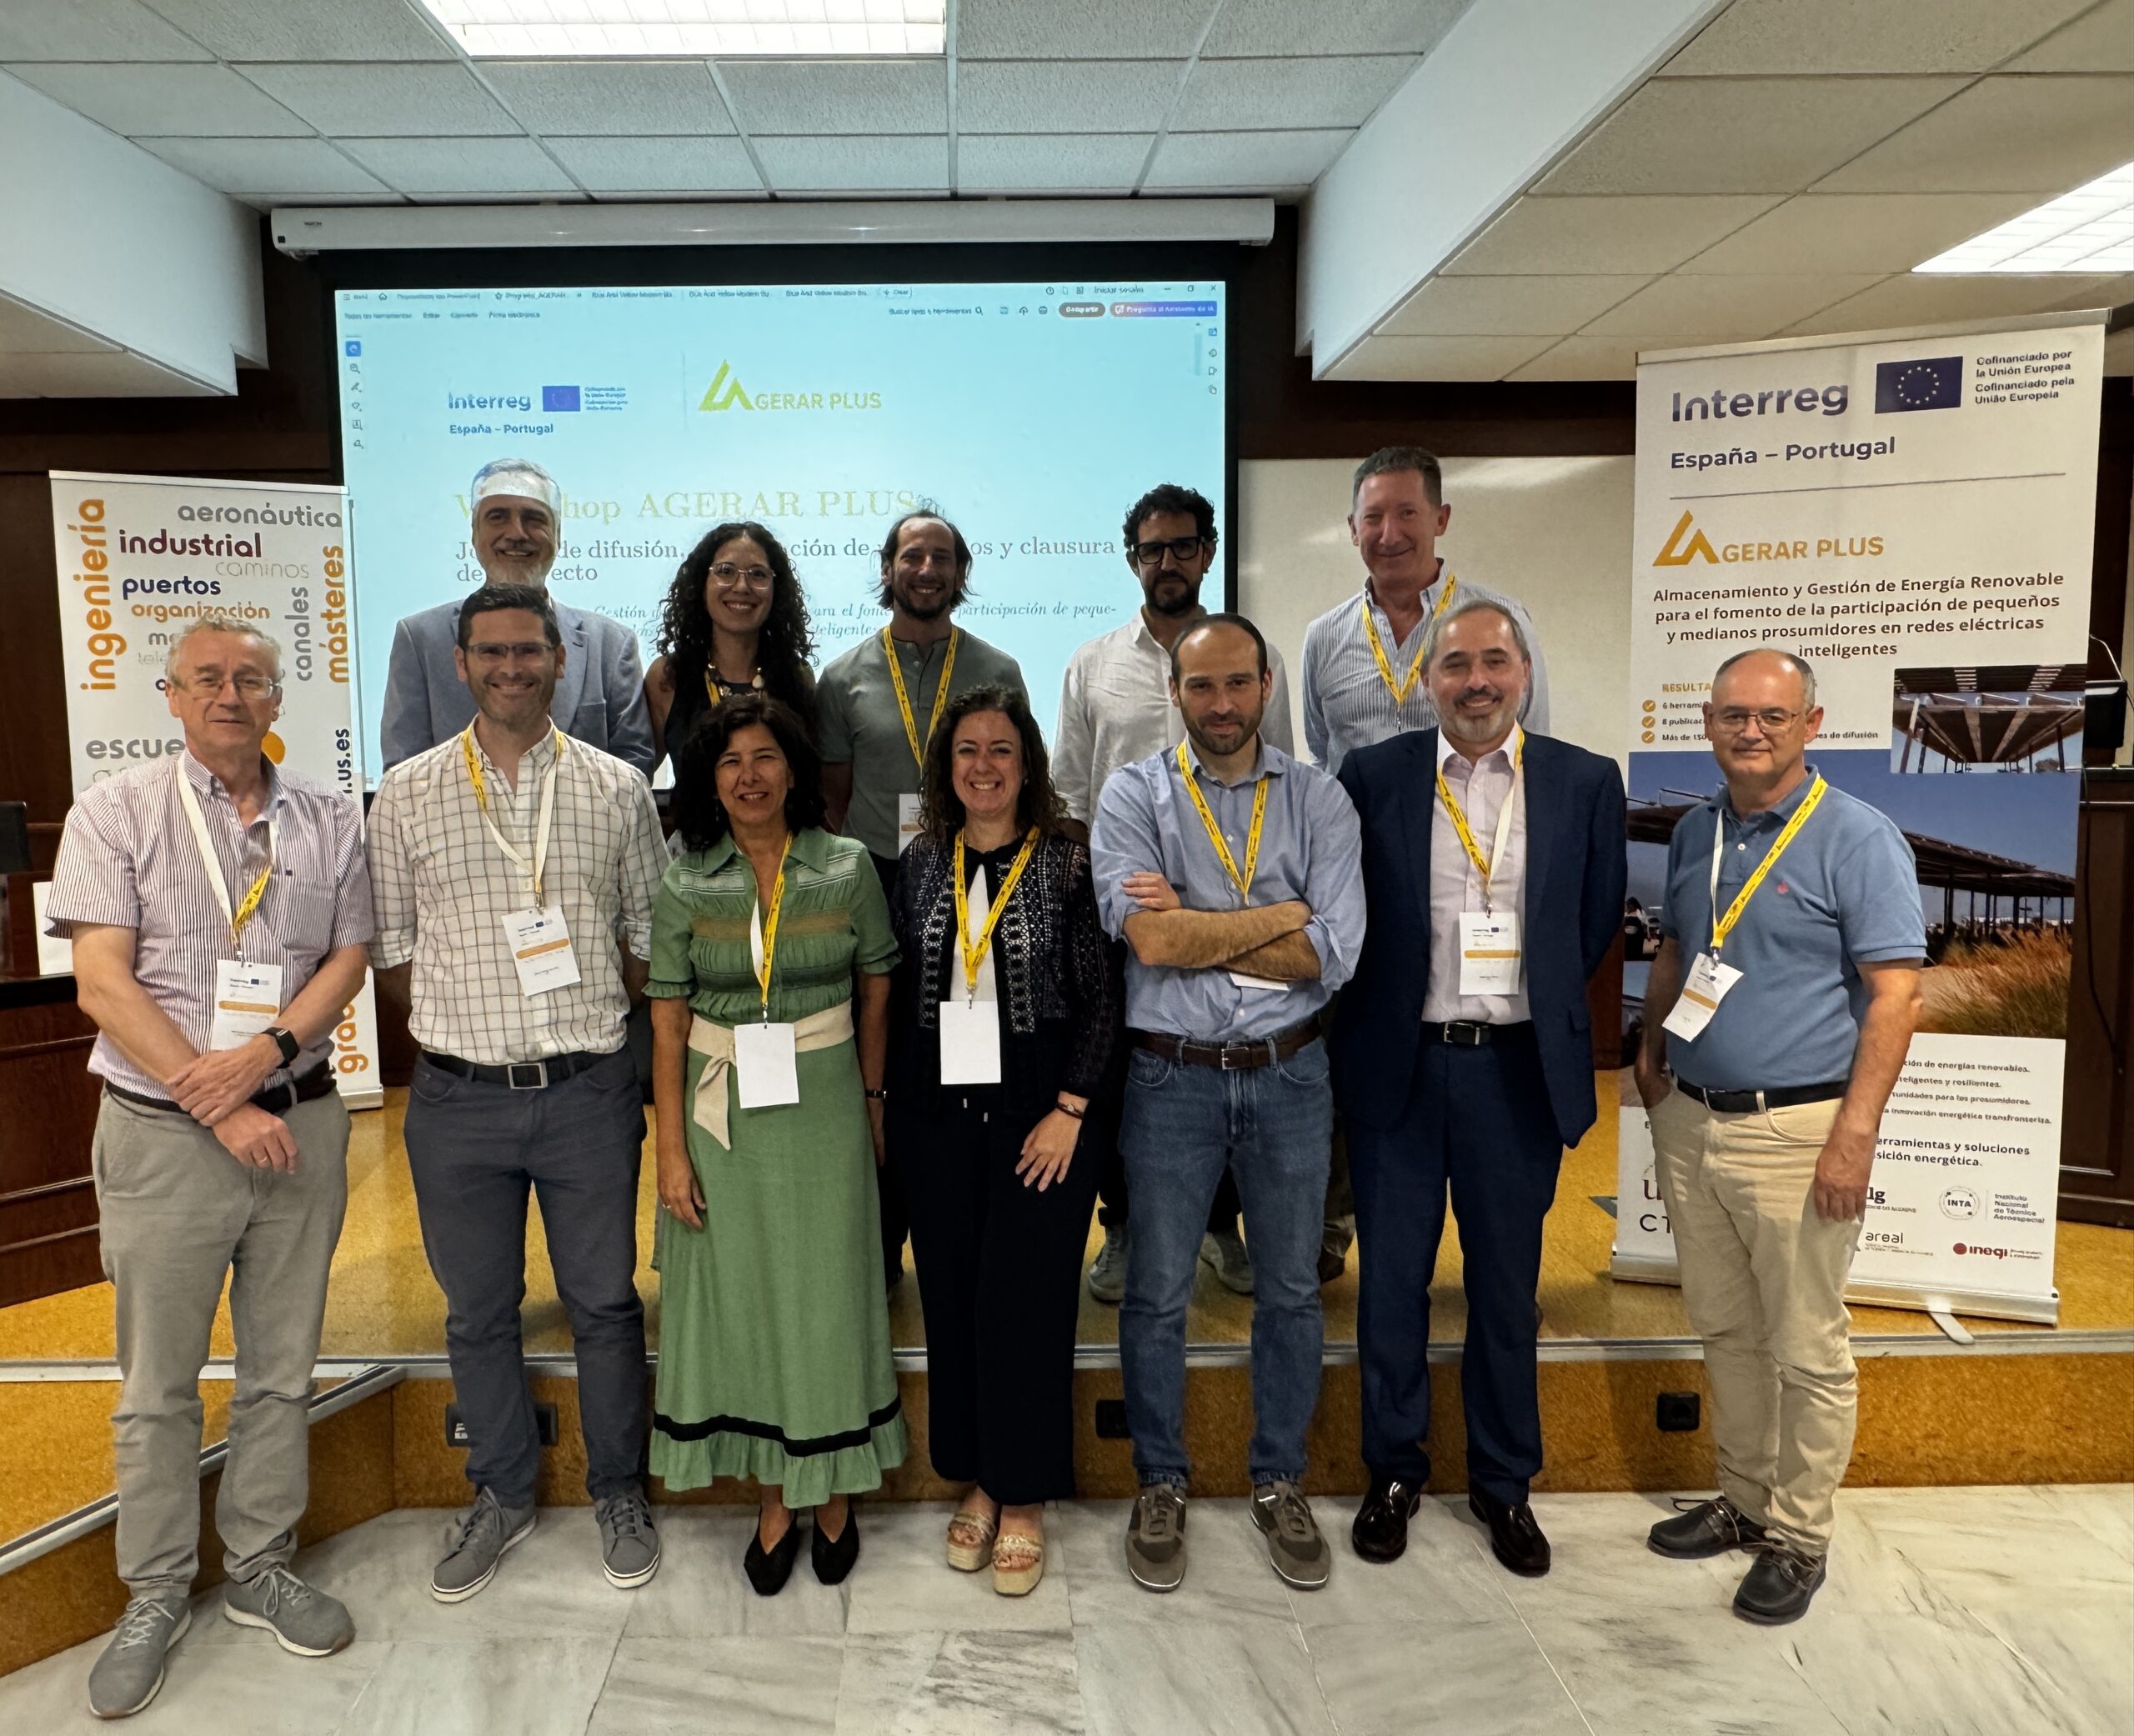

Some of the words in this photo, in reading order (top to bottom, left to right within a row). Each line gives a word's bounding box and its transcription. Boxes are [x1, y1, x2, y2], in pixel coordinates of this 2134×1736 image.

[1976, 352, 2050, 366] Cofinanciado
[2052, 351, 2072, 361] por
[1976, 368, 1986, 378] la
[1988, 367, 2021, 377] Unión
[2024, 363, 2071, 373] Europea
[1975, 379, 2048, 393] Cofinanciado
[448, 393, 532, 412] Interreg
[1672, 385, 1849, 422] Interreg
[449, 424, 492, 436] España
[503, 423, 554, 435] Portugal
[1671, 448, 1757, 471] España
[1786, 436, 1896, 461] Portugal
[178, 502, 342, 527] aeronáutica
[638, 493, 804, 518] AGERAR
[119, 528, 262, 558] industrial
[559, 540, 581, 558] de
[844, 538, 869, 556] de
[999, 543, 1013, 559] y
[1020, 536, 1116, 554] clausura
[1816, 537, 1884, 558] PLUS
[215, 561, 310, 579] caminos
[551, 564, 598, 581] ecto
[68, 498, 126, 690] ingeniería
[123, 576, 221, 600] puertos
[1653, 586, 1789, 602] Almacenamiento
[1793, 585, 1803, 598] y
[1807, 580, 1871, 595] Gestión
[1876, 580, 1896, 593] de
[1901, 577, 1965, 593] Energía
[1971, 573, 2064, 588] Renovable
[319, 545, 348, 683] másteres
[1656, 609, 1691, 624] para
[1695, 608, 1708, 620] el
[1713, 607, 1782, 620] fomento
[1786, 604, 1806, 617] de
[1811, 603, 1825, 615] la
[1831, 598, 1941, 618] participación
[1946, 598, 1968, 611] de
[1972, 595, 2060, 613] pequeños
[285, 587, 313, 681] canales
[1667, 631, 1676, 644] y
[1681, 627, 1757, 641] medianos
[1762, 623, 1876, 641] prosumidores
[1881, 623, 1901, 633] en
[1906, 619, 1954, 633] redes
[1959, 617, 2044, 631] eléctricas
[1799, 643, 1898, 658] inteligentes
[1662, 683, 1711, 693] RESULTA
[86, 738, 186, 759] escue
[1876, 1138, 1951, 1150] erramientas
[1954, 1143, 1961, 1153] y
[1964, 1143, 2031, 1156] soluciones
[1947, 1199, 1971, 1208] INTA
[1866, 1232, 1903, 1244] areal
